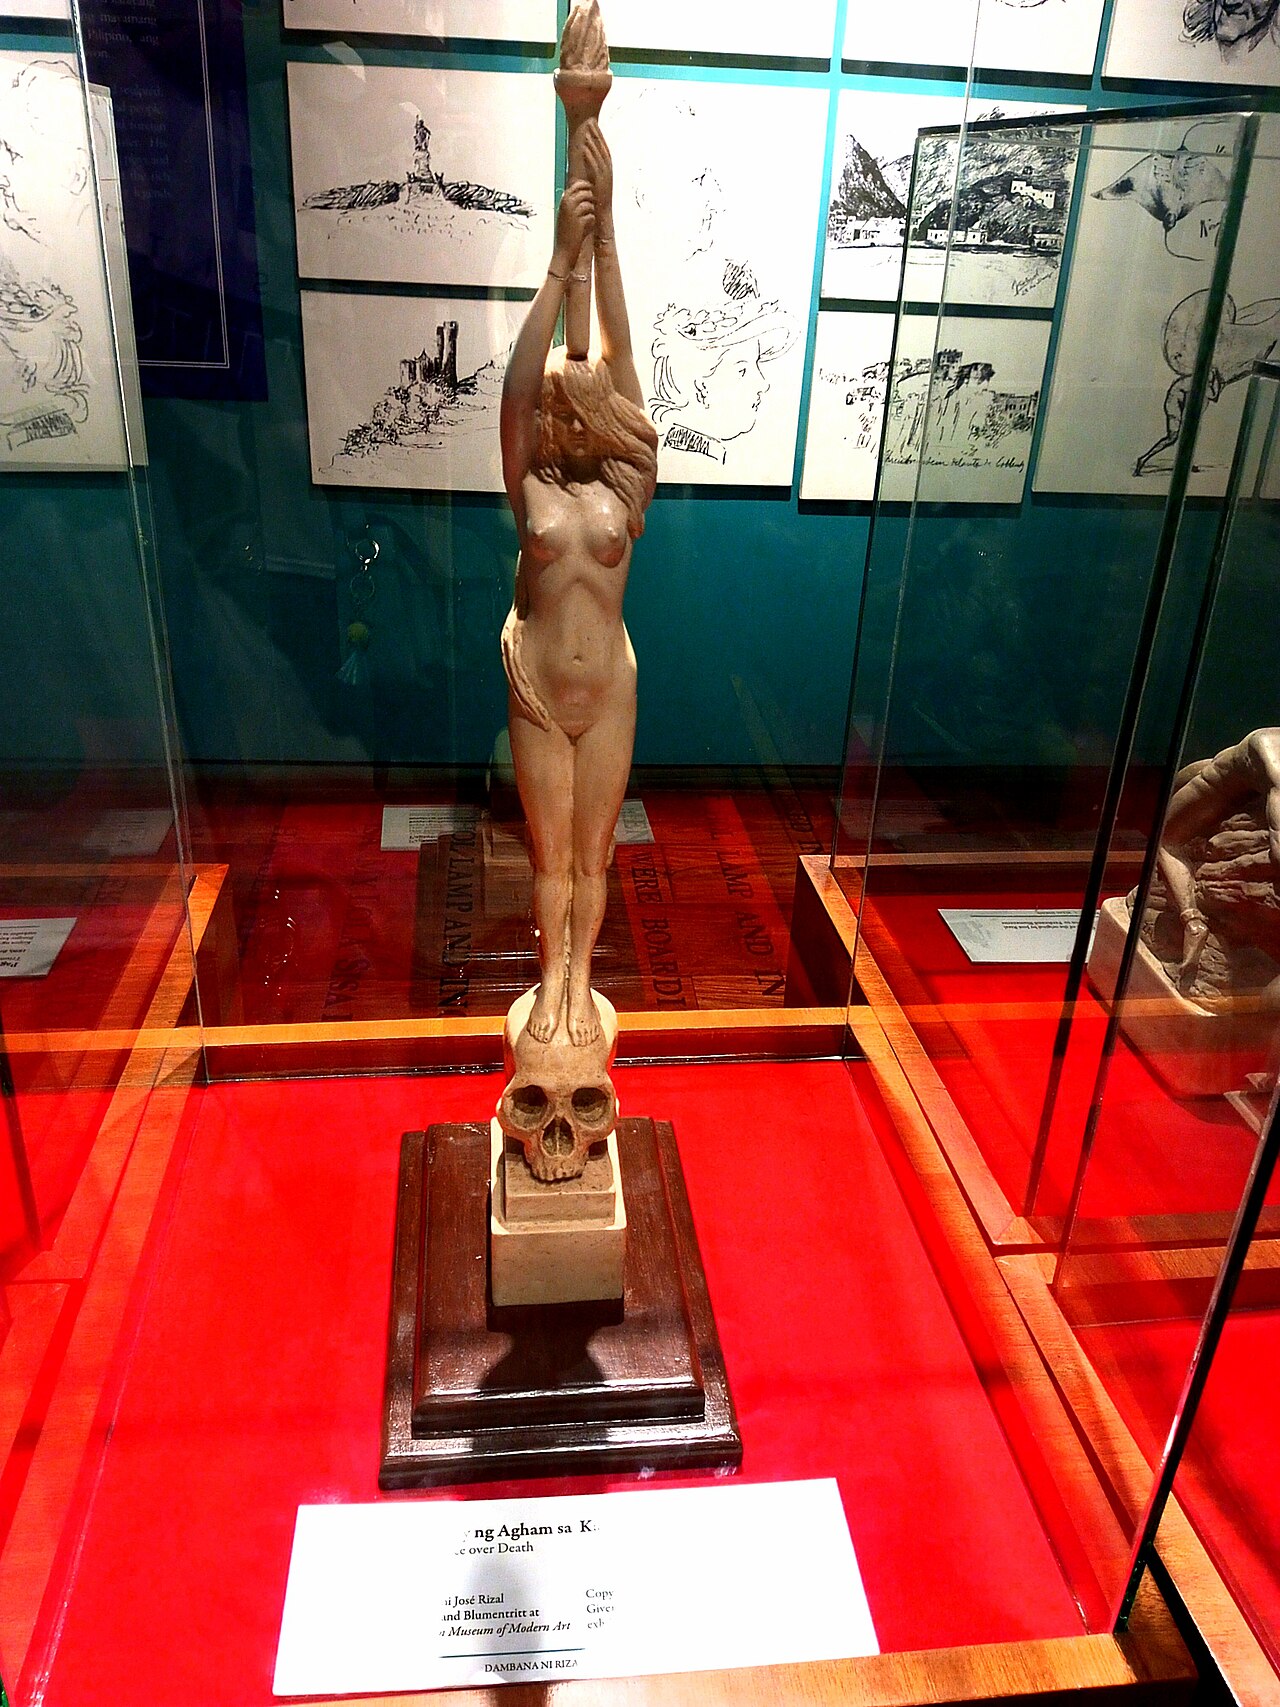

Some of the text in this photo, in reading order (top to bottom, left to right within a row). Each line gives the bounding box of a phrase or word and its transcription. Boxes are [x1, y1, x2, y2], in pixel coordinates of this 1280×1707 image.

[475, 1529, 494, 1542] ng
[497, 1523, 553, 1540] Agham
[557, 1525, 573, 1534] sa
[469, 1547, 495, 1555] over
[498, 1541, 534, 1554] Death
[453, 1594, 476, 1608] José
[478, 1593, 504, 1605] Rizal
[463, 1609, 527, 1621] Blumentritt
[529, 1609, 540, 1617] at
[448, 1626, 494, 1637] Museum
[496, 1623, 508, 1637] of
[508, 1622, 550, 1634] Modern
[553, 1621, 571, 1631] Art
[485, 1662, 539, 1673] DAMBANA
[541, 1660, 553, 1669] NI
